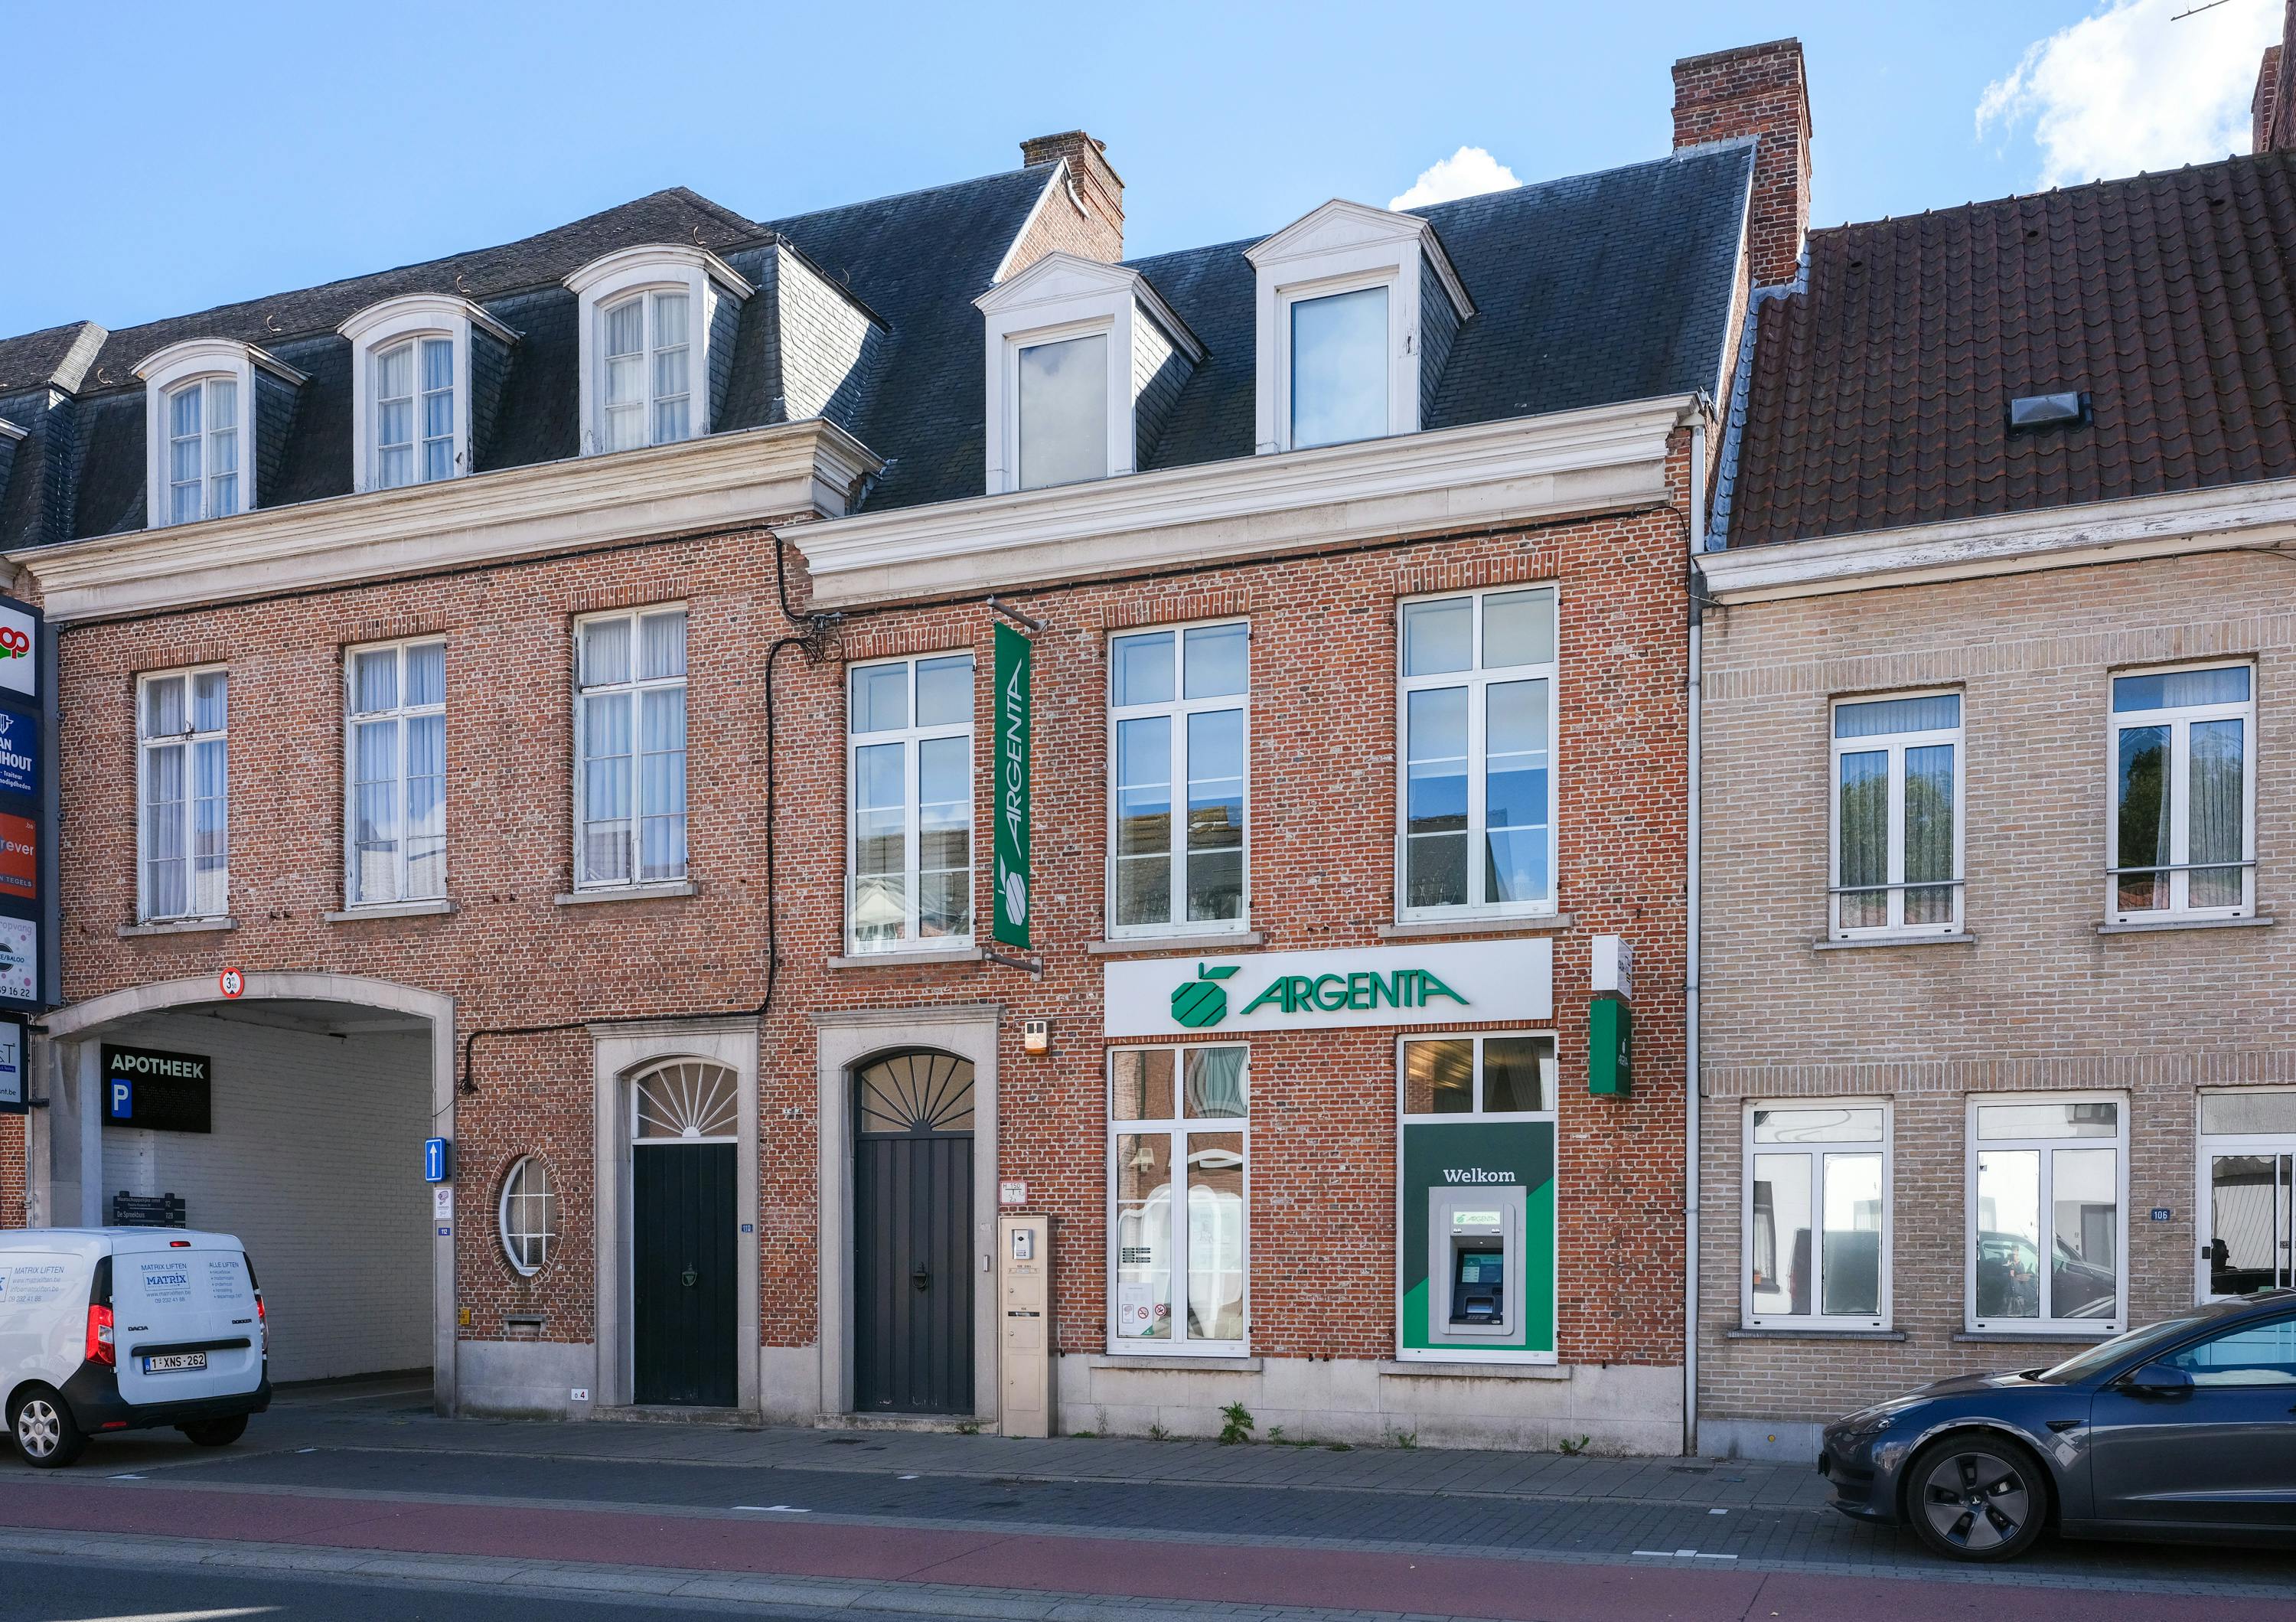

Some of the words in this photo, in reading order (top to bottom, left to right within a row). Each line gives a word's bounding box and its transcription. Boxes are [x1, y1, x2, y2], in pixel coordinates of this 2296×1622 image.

[0, 751, 32, 772] HOUT
[1006, 658, 1022, 860] ARGENTA
[4, 770, 23, 781] Traiteur
[6, 876, 32, 887] TEGELS
[9, 987, 18, 996] 16
[21, 988, 31, 997] 22
[1240, 969, 1470, 1015] ARGENTA
[110, 1053, 204, 1079] APOTHEEK
[113, 1084, 129, 1111] P
[1443, 1168, 1516, 1183] Welkom
[2154, 1211, 2168, 1219] 106
[146, 1274, 187, 1285] MATRIX
